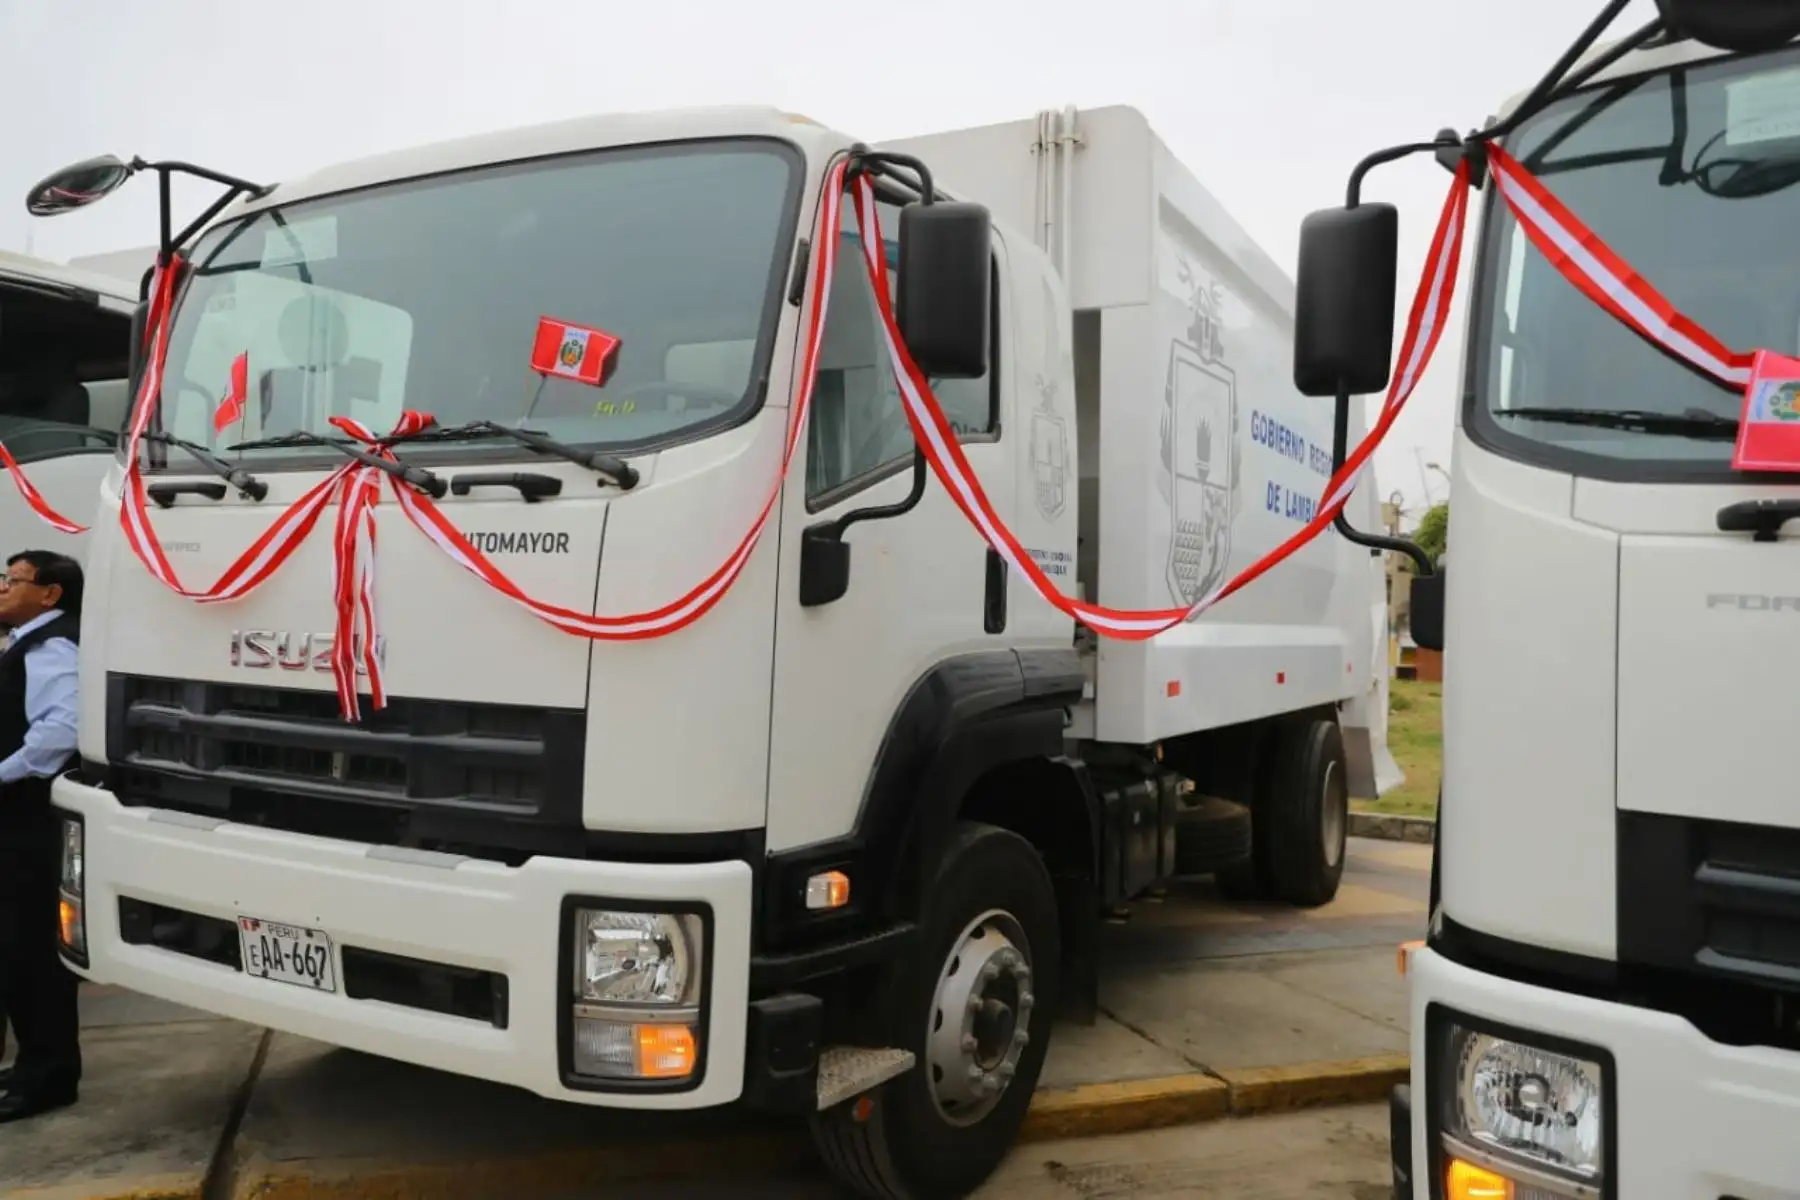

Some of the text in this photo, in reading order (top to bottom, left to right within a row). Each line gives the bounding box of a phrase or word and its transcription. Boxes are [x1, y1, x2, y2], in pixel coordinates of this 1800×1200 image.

[1251, 409, 1304, 464] GOBIERNO
[1267, 480, 1281, 514] DE
[463, 532, 570, 554] UTOMAYOR
